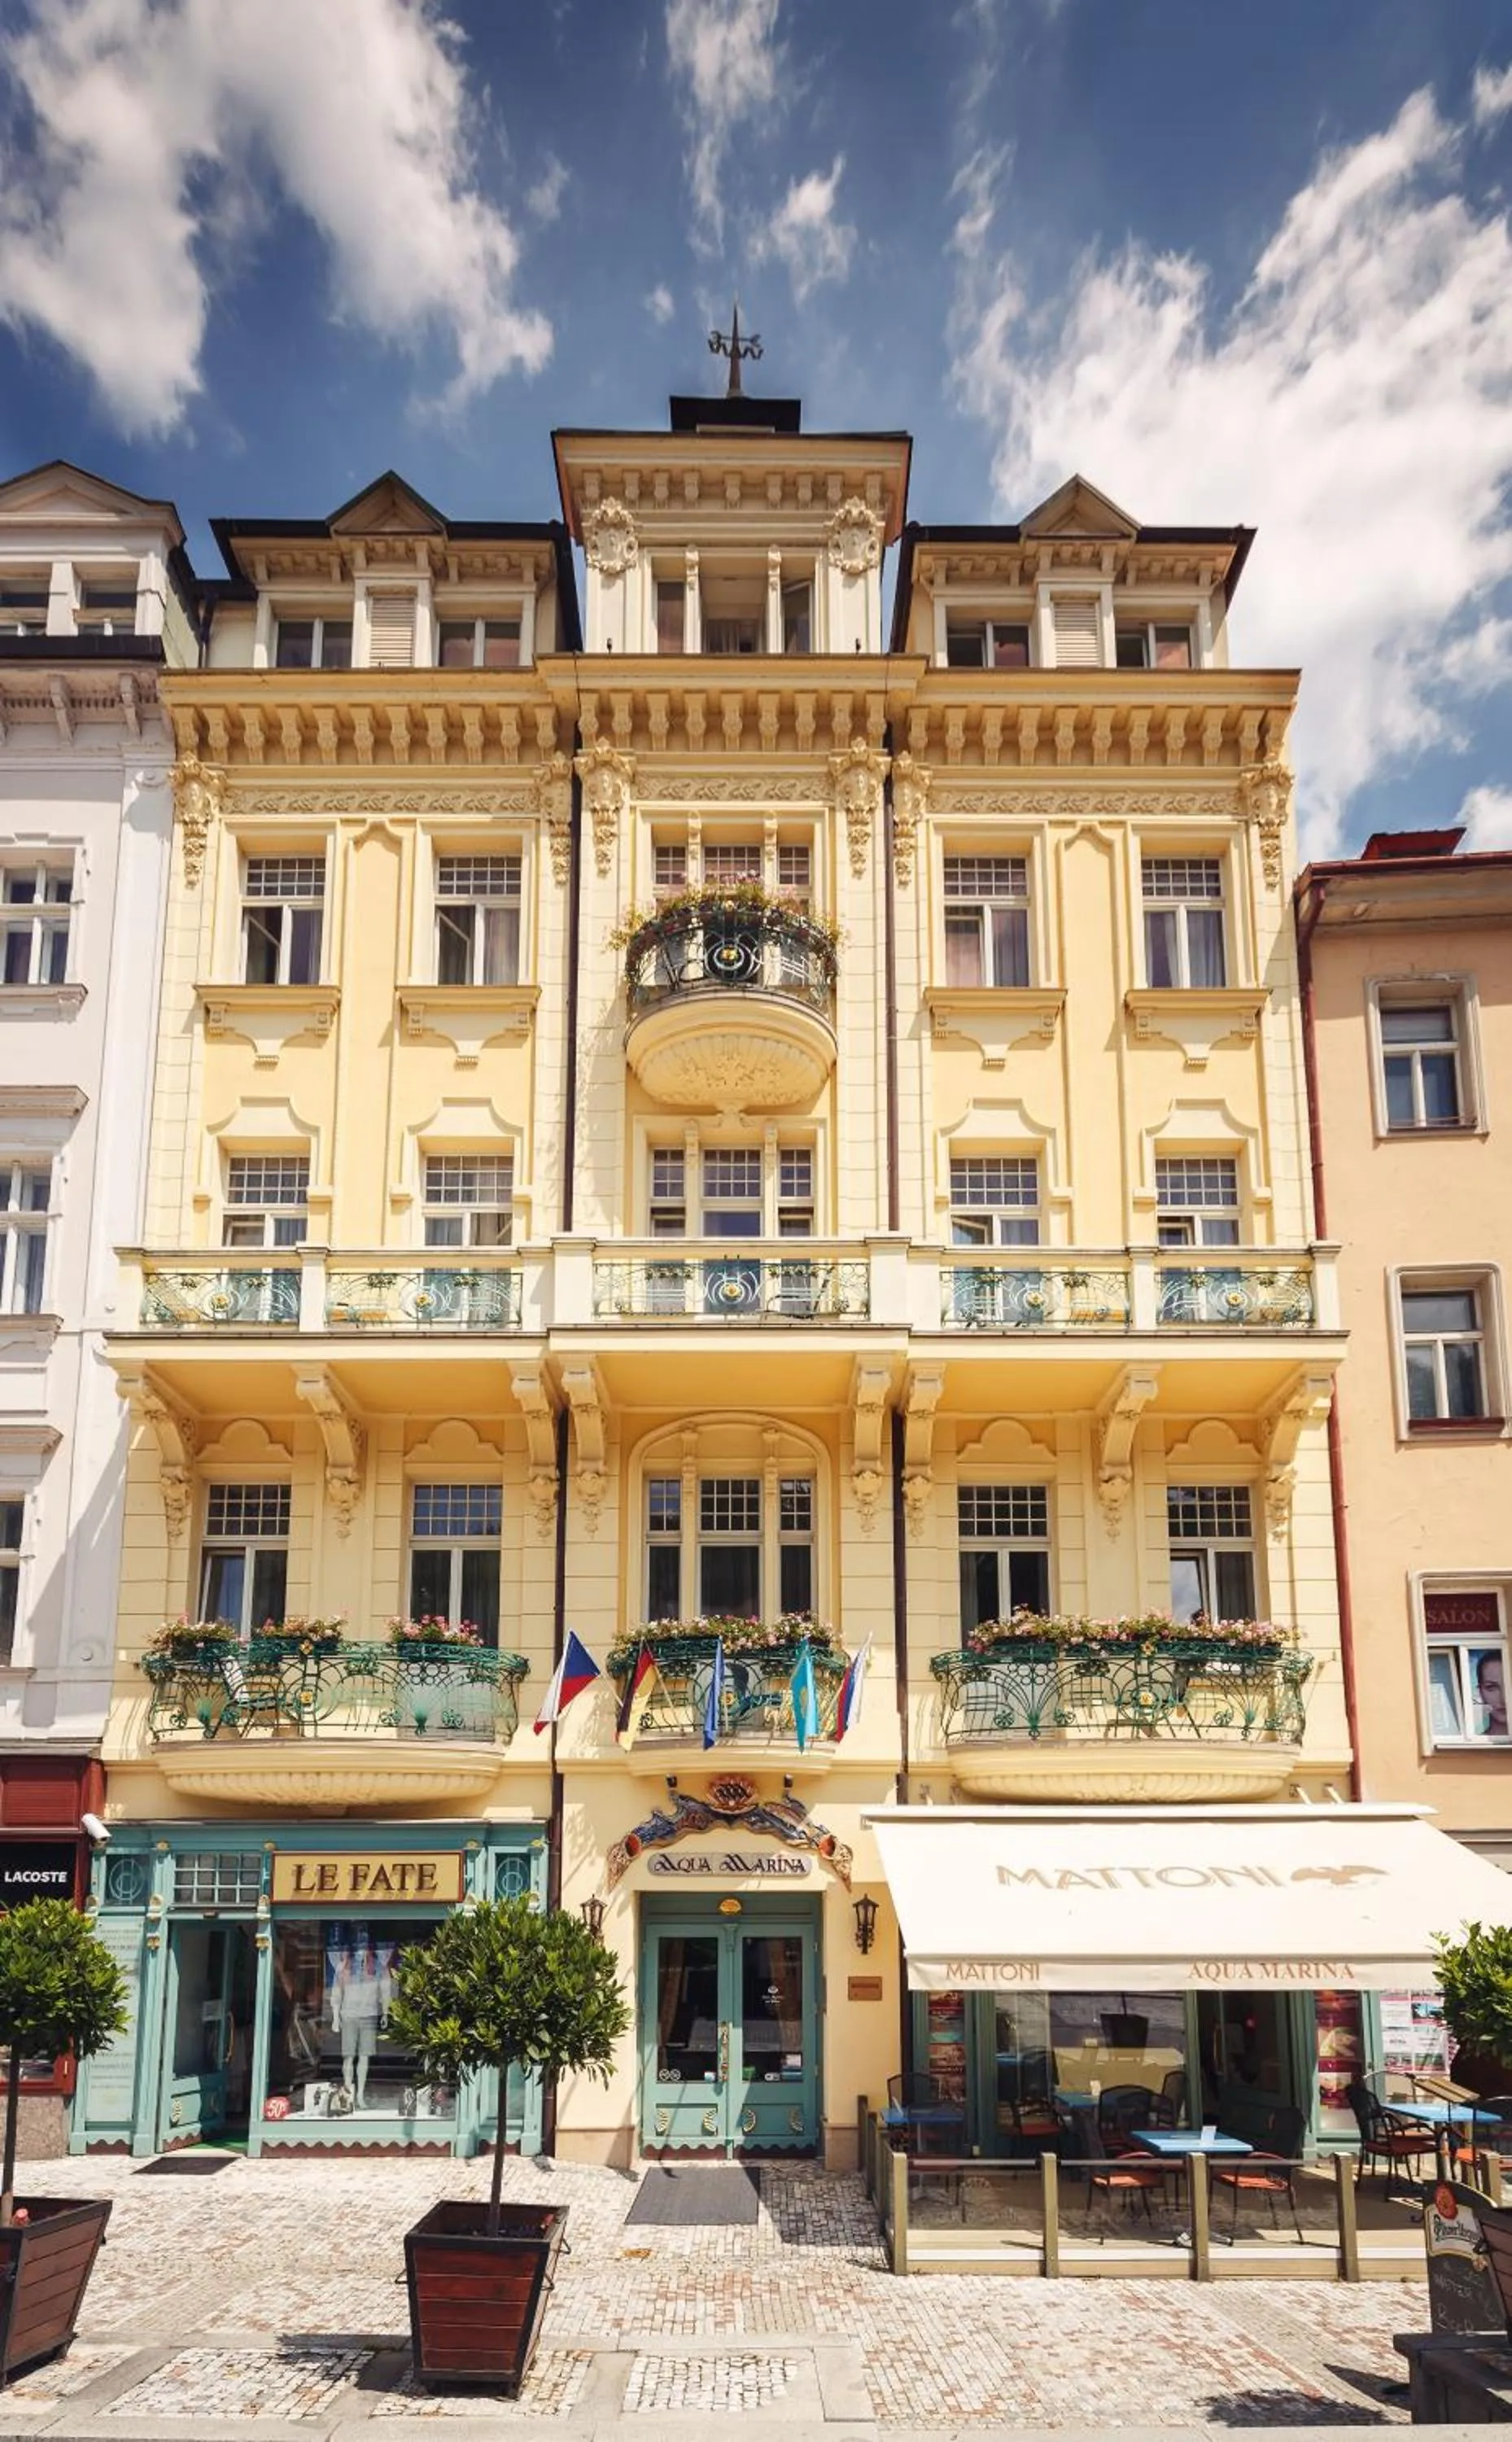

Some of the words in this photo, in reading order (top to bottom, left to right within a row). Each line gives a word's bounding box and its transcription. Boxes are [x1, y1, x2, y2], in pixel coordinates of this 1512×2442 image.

[1427, 1610, 1491, 1624] SALON
[653, 1853, 712, 1873] AQUA
[719, 1853, 806, 1873] MARINA
[4, 1871, 68, 1883] LACOSTE
[293, 1863, 339, 1891] LE
[348, 1863, 439, 1891] FATE
[994, 1865, 1286, 1889] MATTONI
[946, 1962, 1040, 1980] MATTONI
[1187, 1961, 1254, 1983] AQUA
[1259, 1962, 1356, 1980] MARINA
